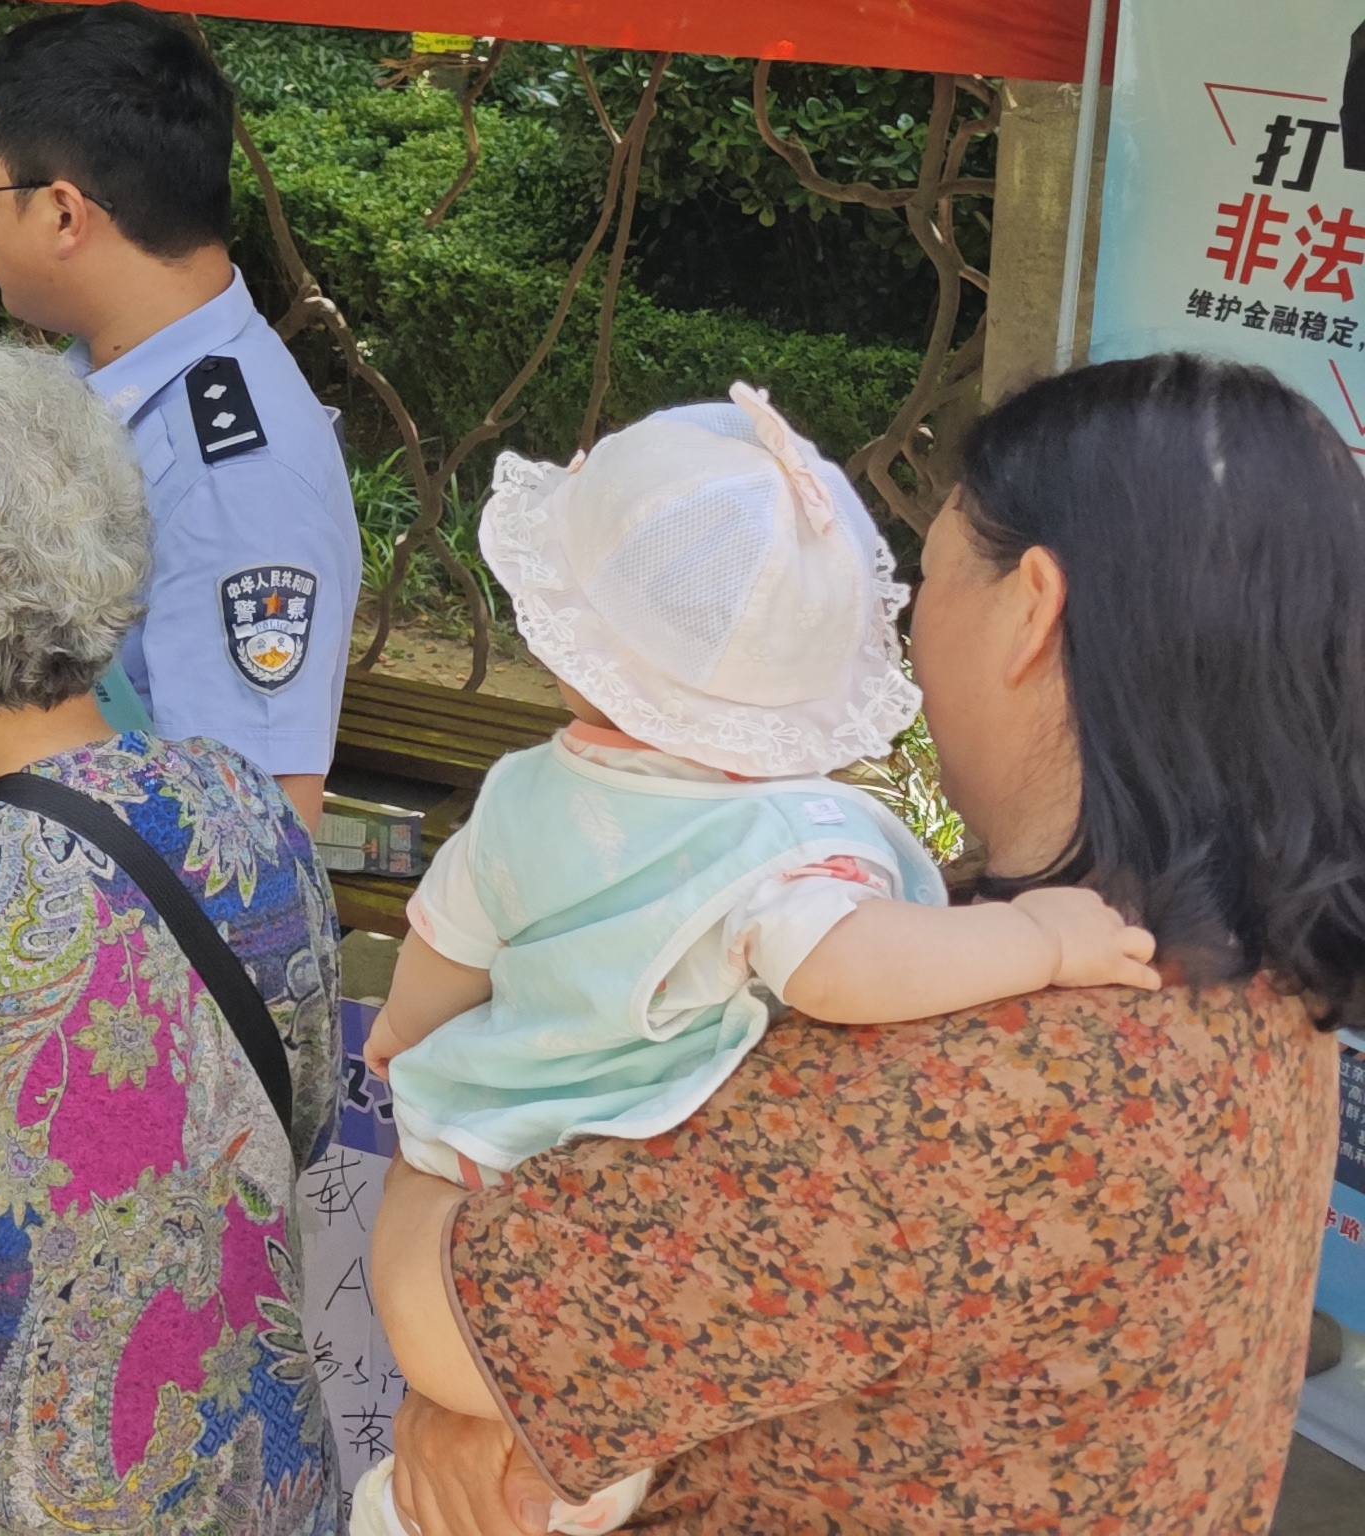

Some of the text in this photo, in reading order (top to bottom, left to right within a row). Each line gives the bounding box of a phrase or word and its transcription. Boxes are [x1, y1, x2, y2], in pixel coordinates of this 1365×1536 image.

[1205, 192, 1365, 303] 非法
[226, 569, 315, 599] 中华人民共和国
